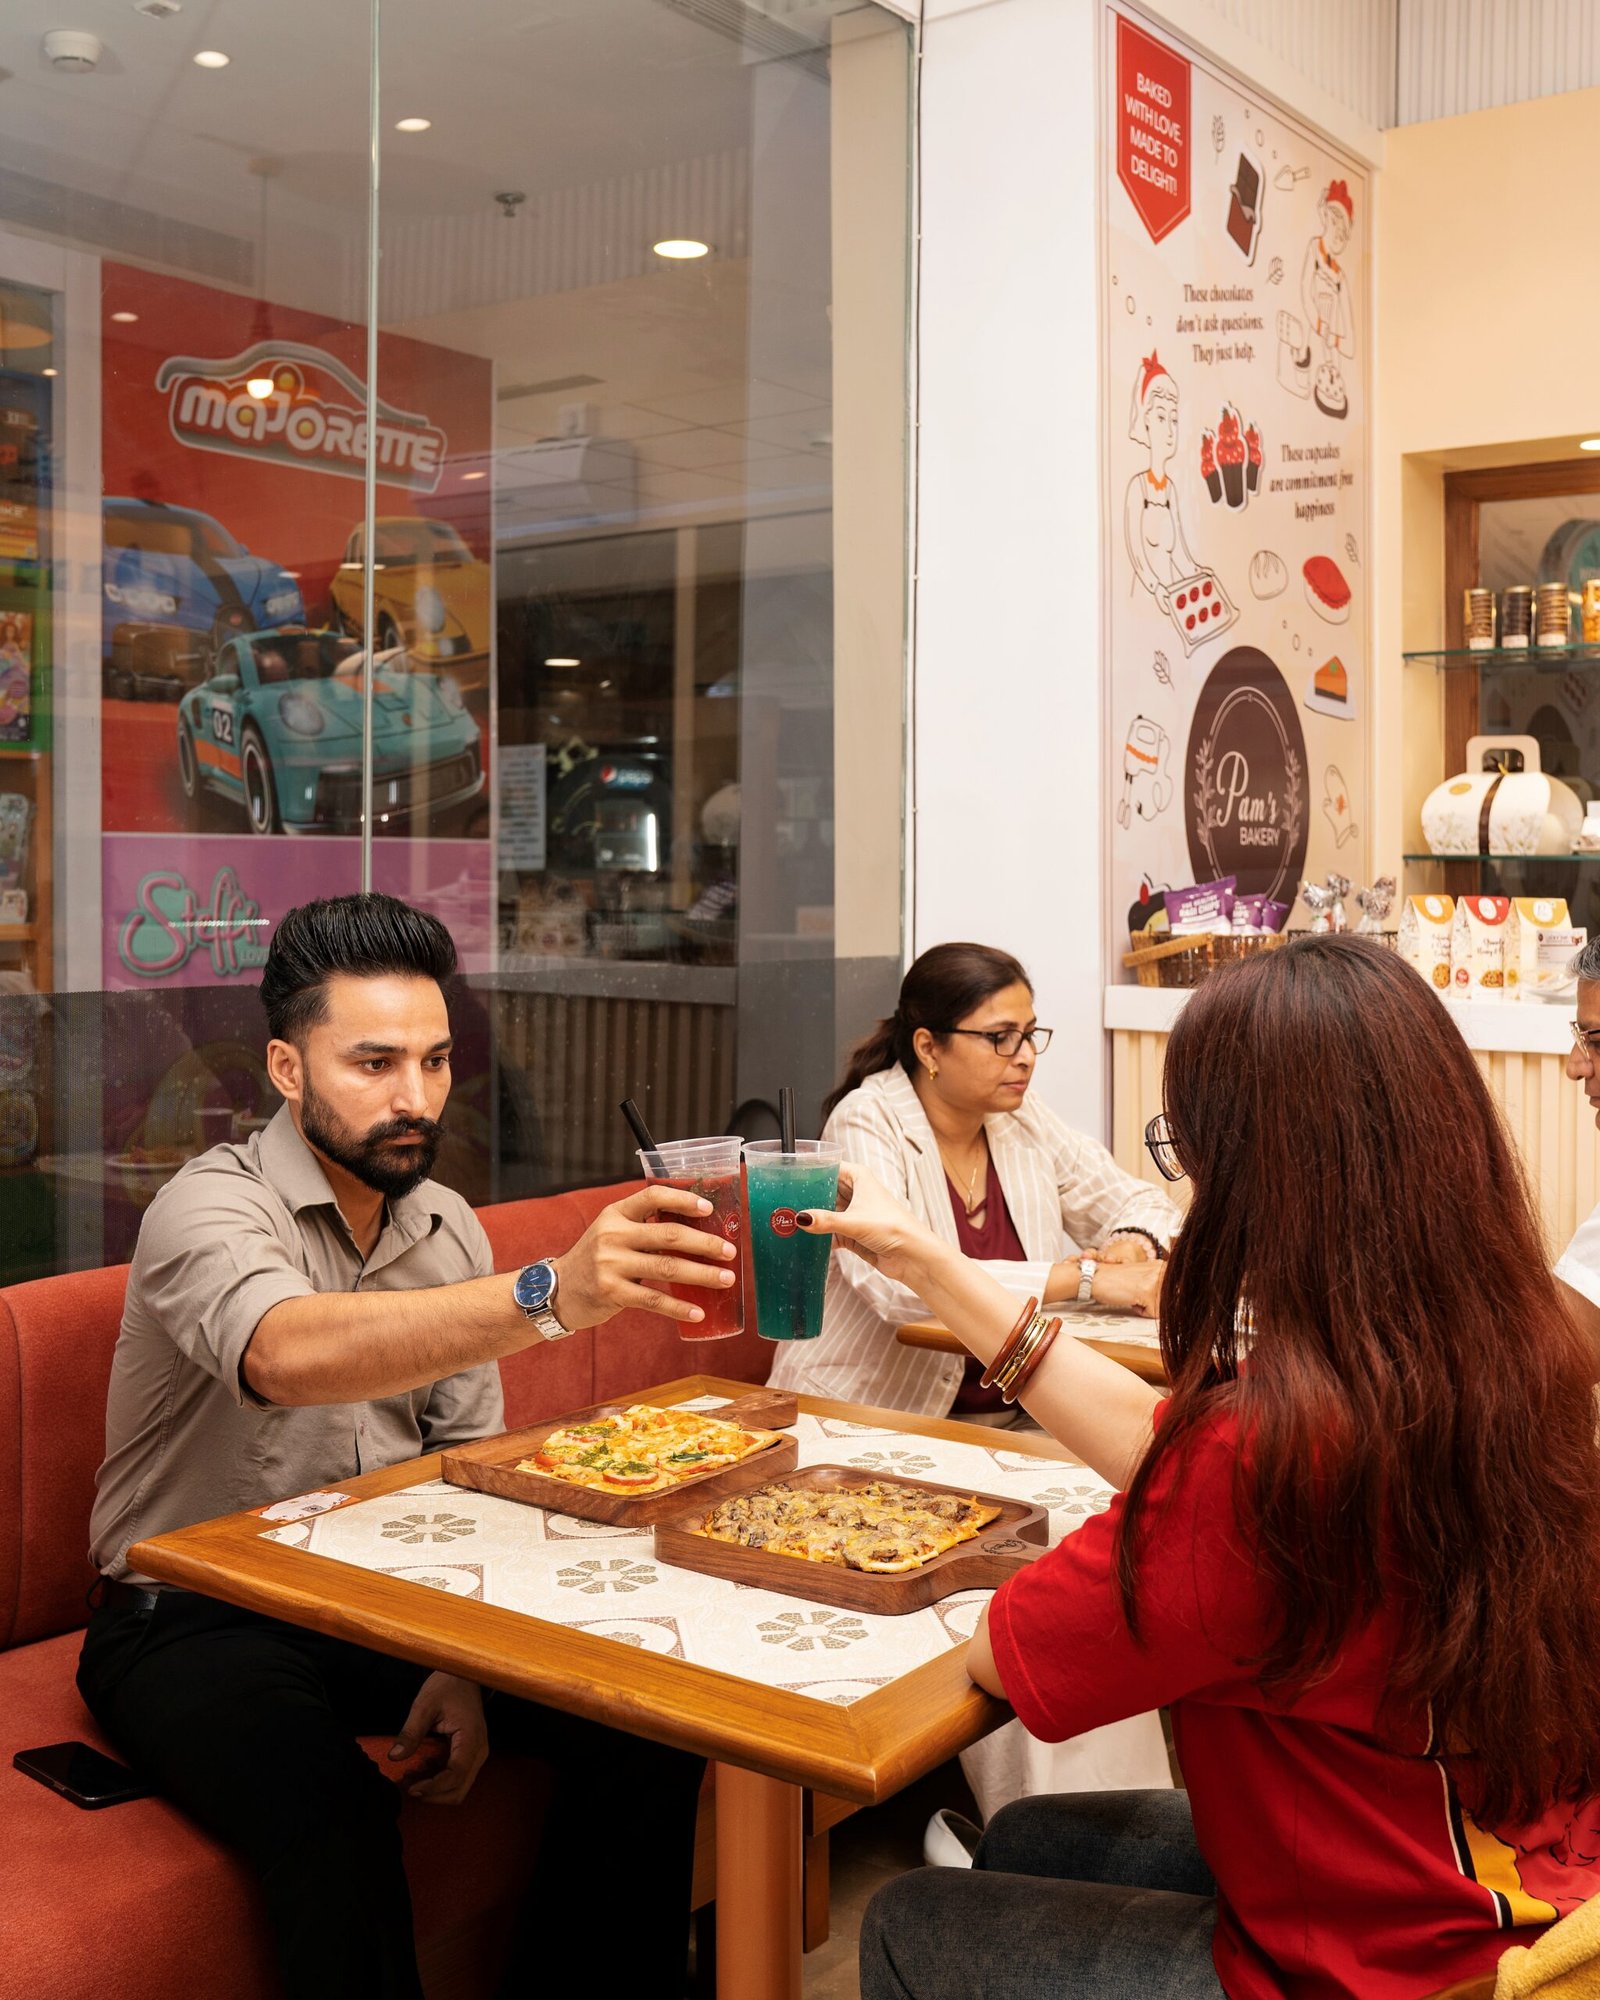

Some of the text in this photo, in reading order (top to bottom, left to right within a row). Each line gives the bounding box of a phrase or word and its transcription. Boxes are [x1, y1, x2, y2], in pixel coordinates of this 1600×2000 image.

[1137, 72, 1172, 108] BAKED
[1125, 93, 1183, 147] WITH LOVE,
[1130, 125, 1178, 169] MADE TO
[1131, 154, 1178, 196] DELIGHT!
[1183, 284, 1254, 303] These chocolates
[1176, 315, 1201, 333] don't
[1204, 313, 1218, 332] ask
[1192, 344, 1213, 365] They
[1215, 342, 1232, 363] just
[1281, 442, 1340, 464] These cupcakes
[1269, 479, 1283, 492] are
[1285, 470, 1337, 492] commitment
[1295, 498, 1334, 522] happiness
[212, 710, 232, 743] 02
[1216, 751, 1276, 827] Pam's
[1239, 826, 1280, 846] BAKERY
[121, 870, 258, 975] Steffi
